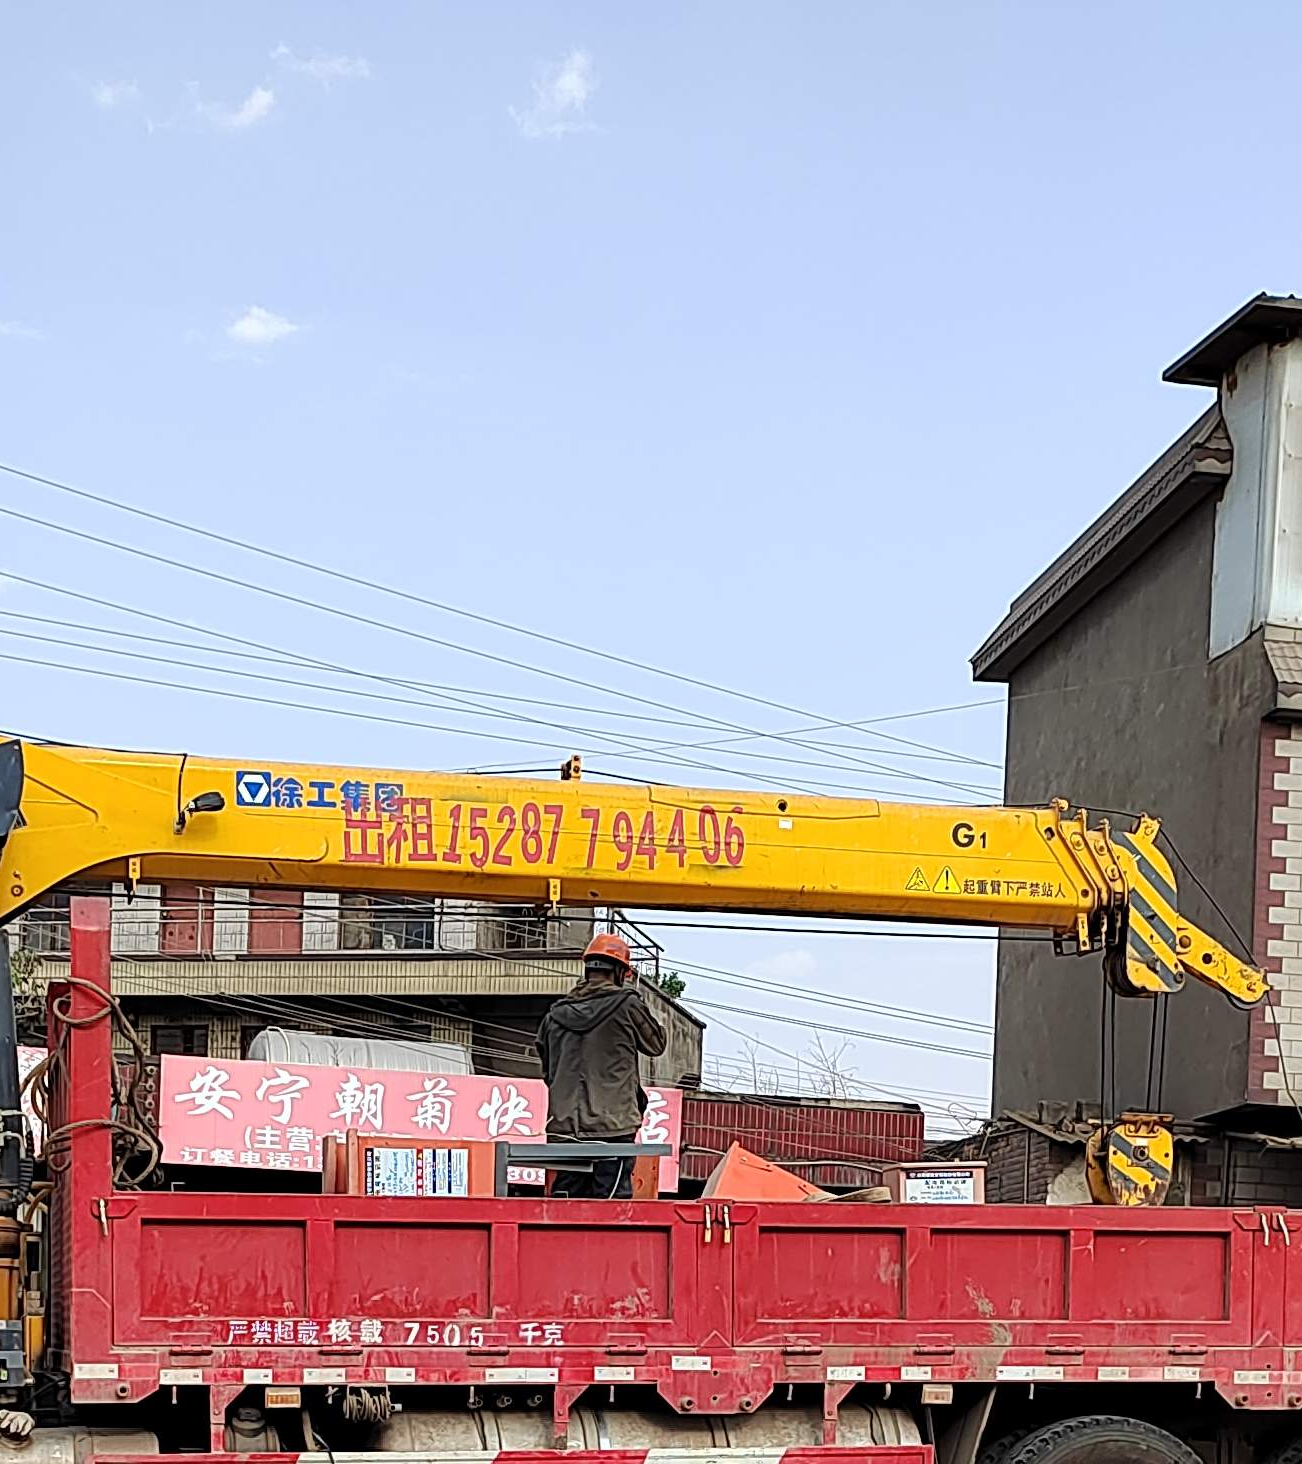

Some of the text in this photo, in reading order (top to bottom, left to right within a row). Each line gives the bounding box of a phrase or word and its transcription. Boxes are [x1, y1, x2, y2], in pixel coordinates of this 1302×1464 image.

[272, 776, 404, 812] 徐工集团
[952, 822, 987, 849] G1
[963, 878, 1066, 898] 起重臂下严禁站人
[519, 1322, 565, 1346] 千克
